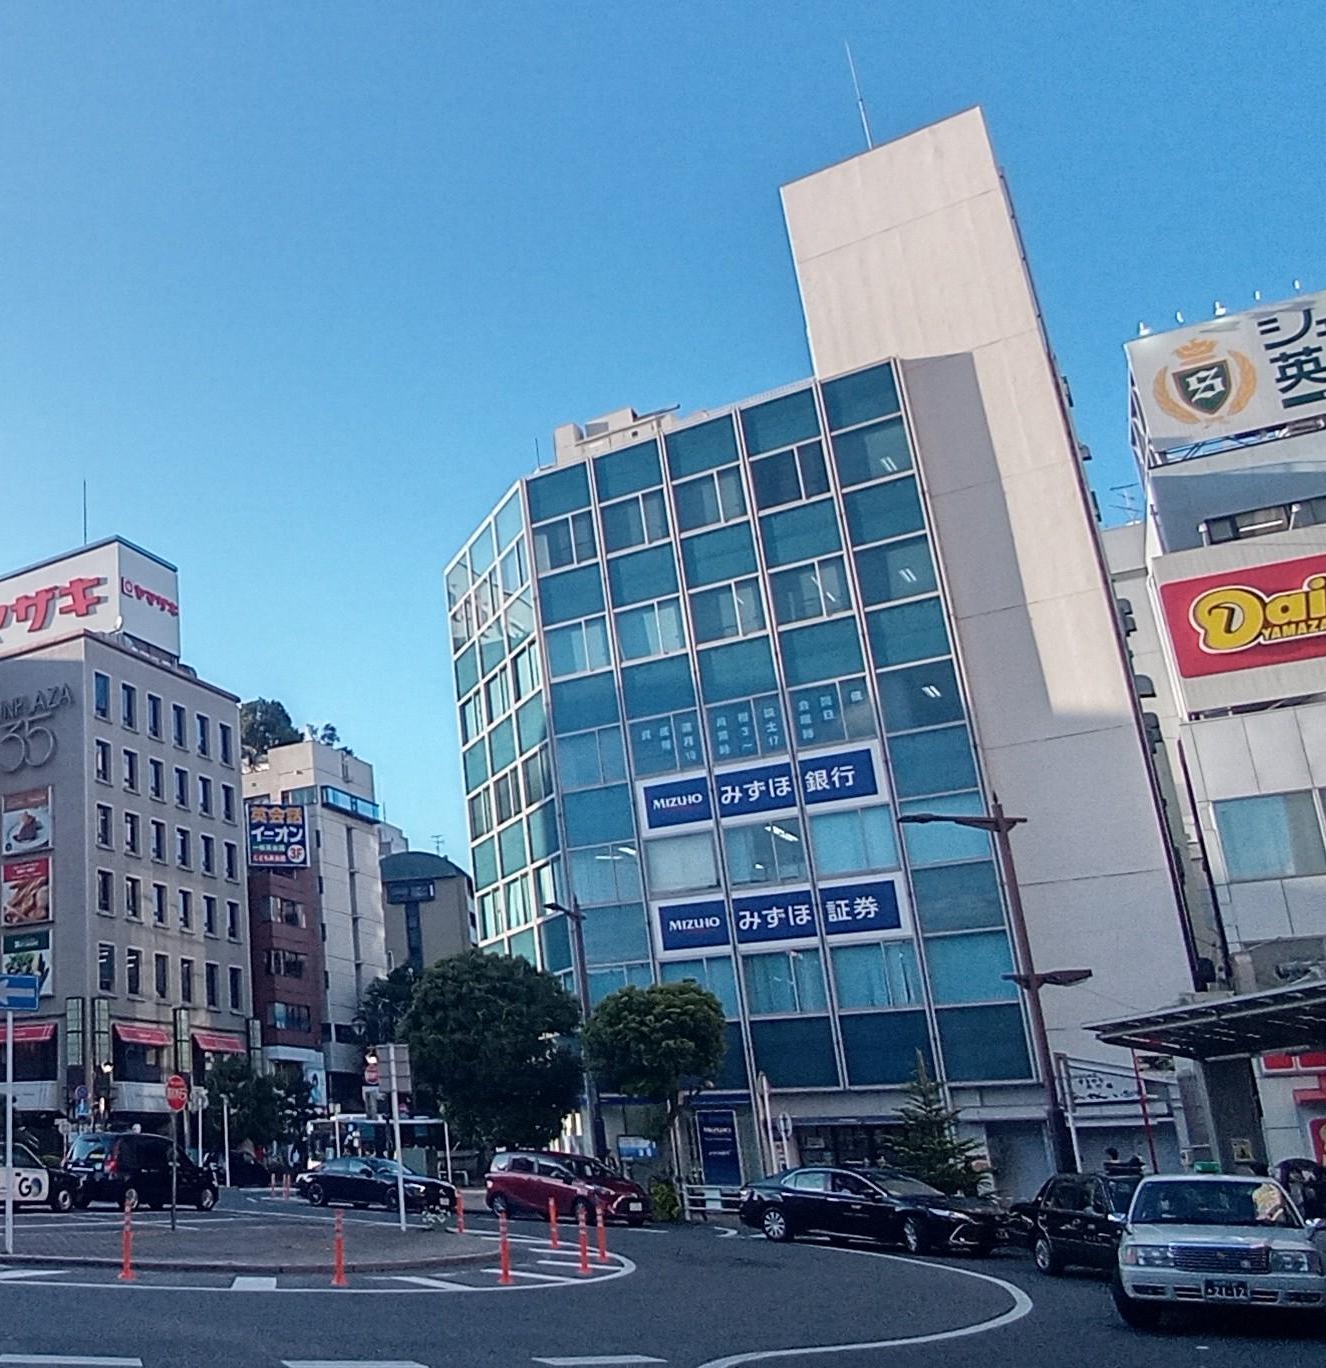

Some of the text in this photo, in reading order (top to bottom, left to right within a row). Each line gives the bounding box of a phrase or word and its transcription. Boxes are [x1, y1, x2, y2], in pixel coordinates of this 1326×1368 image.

[0, 712, 57, 773] 35
[720, 764, 857, 805] みずほ銀行
[251, 825, 303, 843] イーオン
[738, 896, 880, 931] みずほ証券
[18, 1177, 42, 1197] GO
